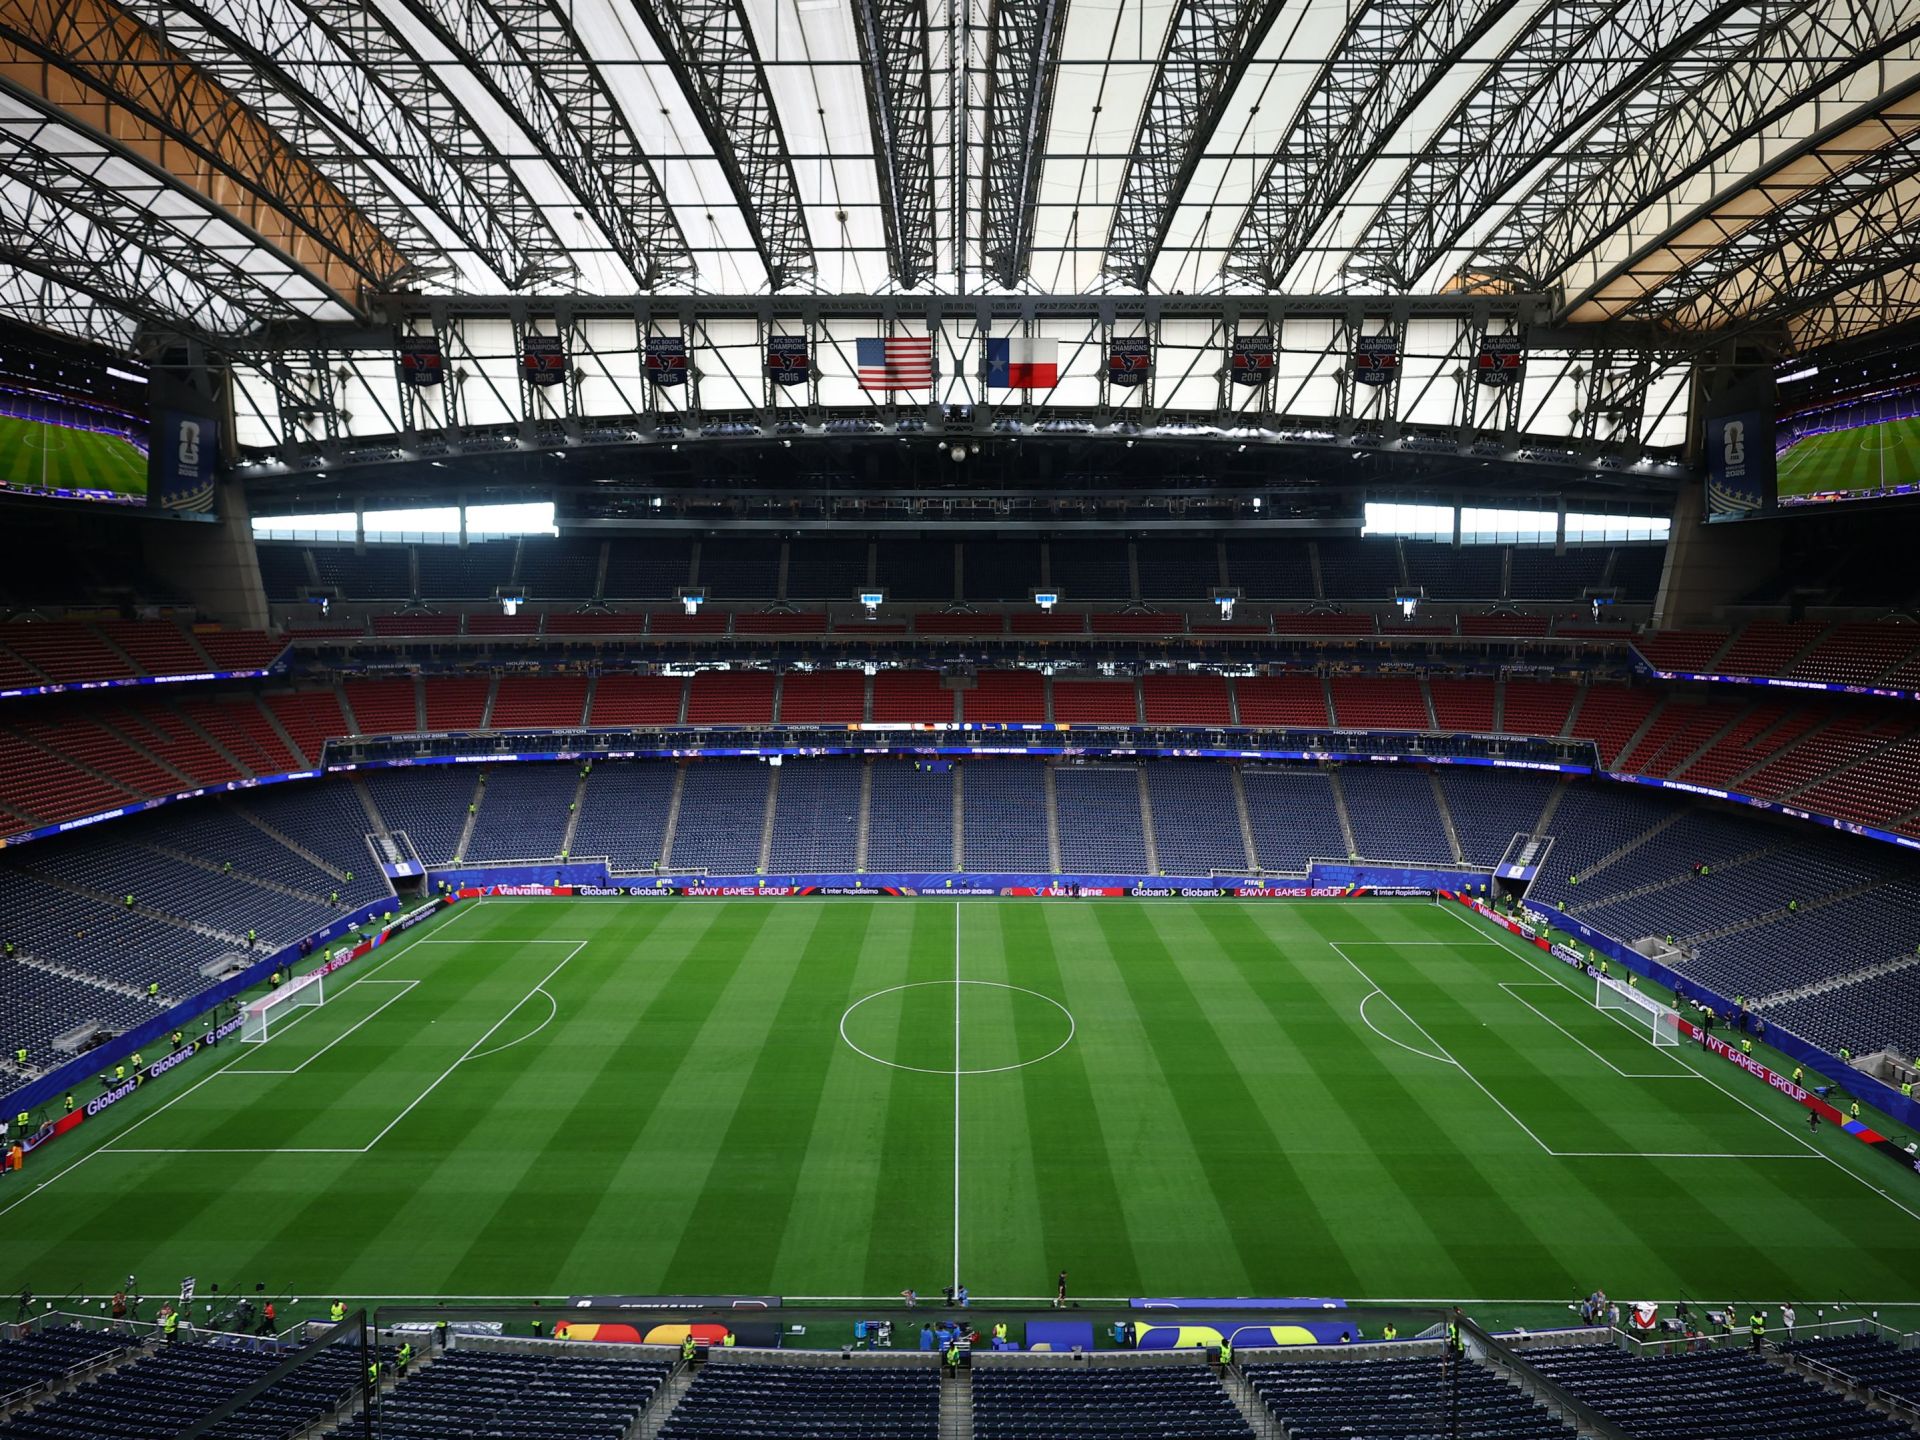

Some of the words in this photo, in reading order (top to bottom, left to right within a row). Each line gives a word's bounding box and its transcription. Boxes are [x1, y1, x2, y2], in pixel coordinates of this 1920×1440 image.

[658, 374, 678, 382] 2015
[779, 373, 798, 382] 2016
[1118, 374, 1137, 383] 2018
[1241, 372, 1262, 381] 2019
[1365, 372, 1385, 381] 2023
[1485, 373, 1509, 382] 2024
[1676, 783, 1697, 792] WORLD
[1708, 789, 1728, 798] 2026
[498, 886, 552, 895] Valvoline
[580, 888, 617, 896] Globant
[630, 888, 667, 896] Globant
[688, 888, 718, 896] SAVVY
[723, 888, 754, 896] GAMES
[759, 888, 788, 896] GROUP
[1132, 888, 1169, 896] Globant
[1182, 888, 1219, 896] Globant
[1240, 889, 1270, 897] SAVVY
[1275, 889, 1306, 897] GAMES
[1311, 889, 1341, 897] GROUP
[1478, 904, 1509, 928] Valvoline
[1580, 926, 1590, 937] FIFA
[331, 951, 354, 970] GROUP
[1551, 944, 1578, 968] Globant
[206, 1016, 243, 1044] Gobant
[151, 1042, 194, 1077] Globant
[1728, 1049, 1764, 1078] GAMES
[1769, 1075, 1806, 1101] GROUP
[87, 1078, 136, 1116] Globant
